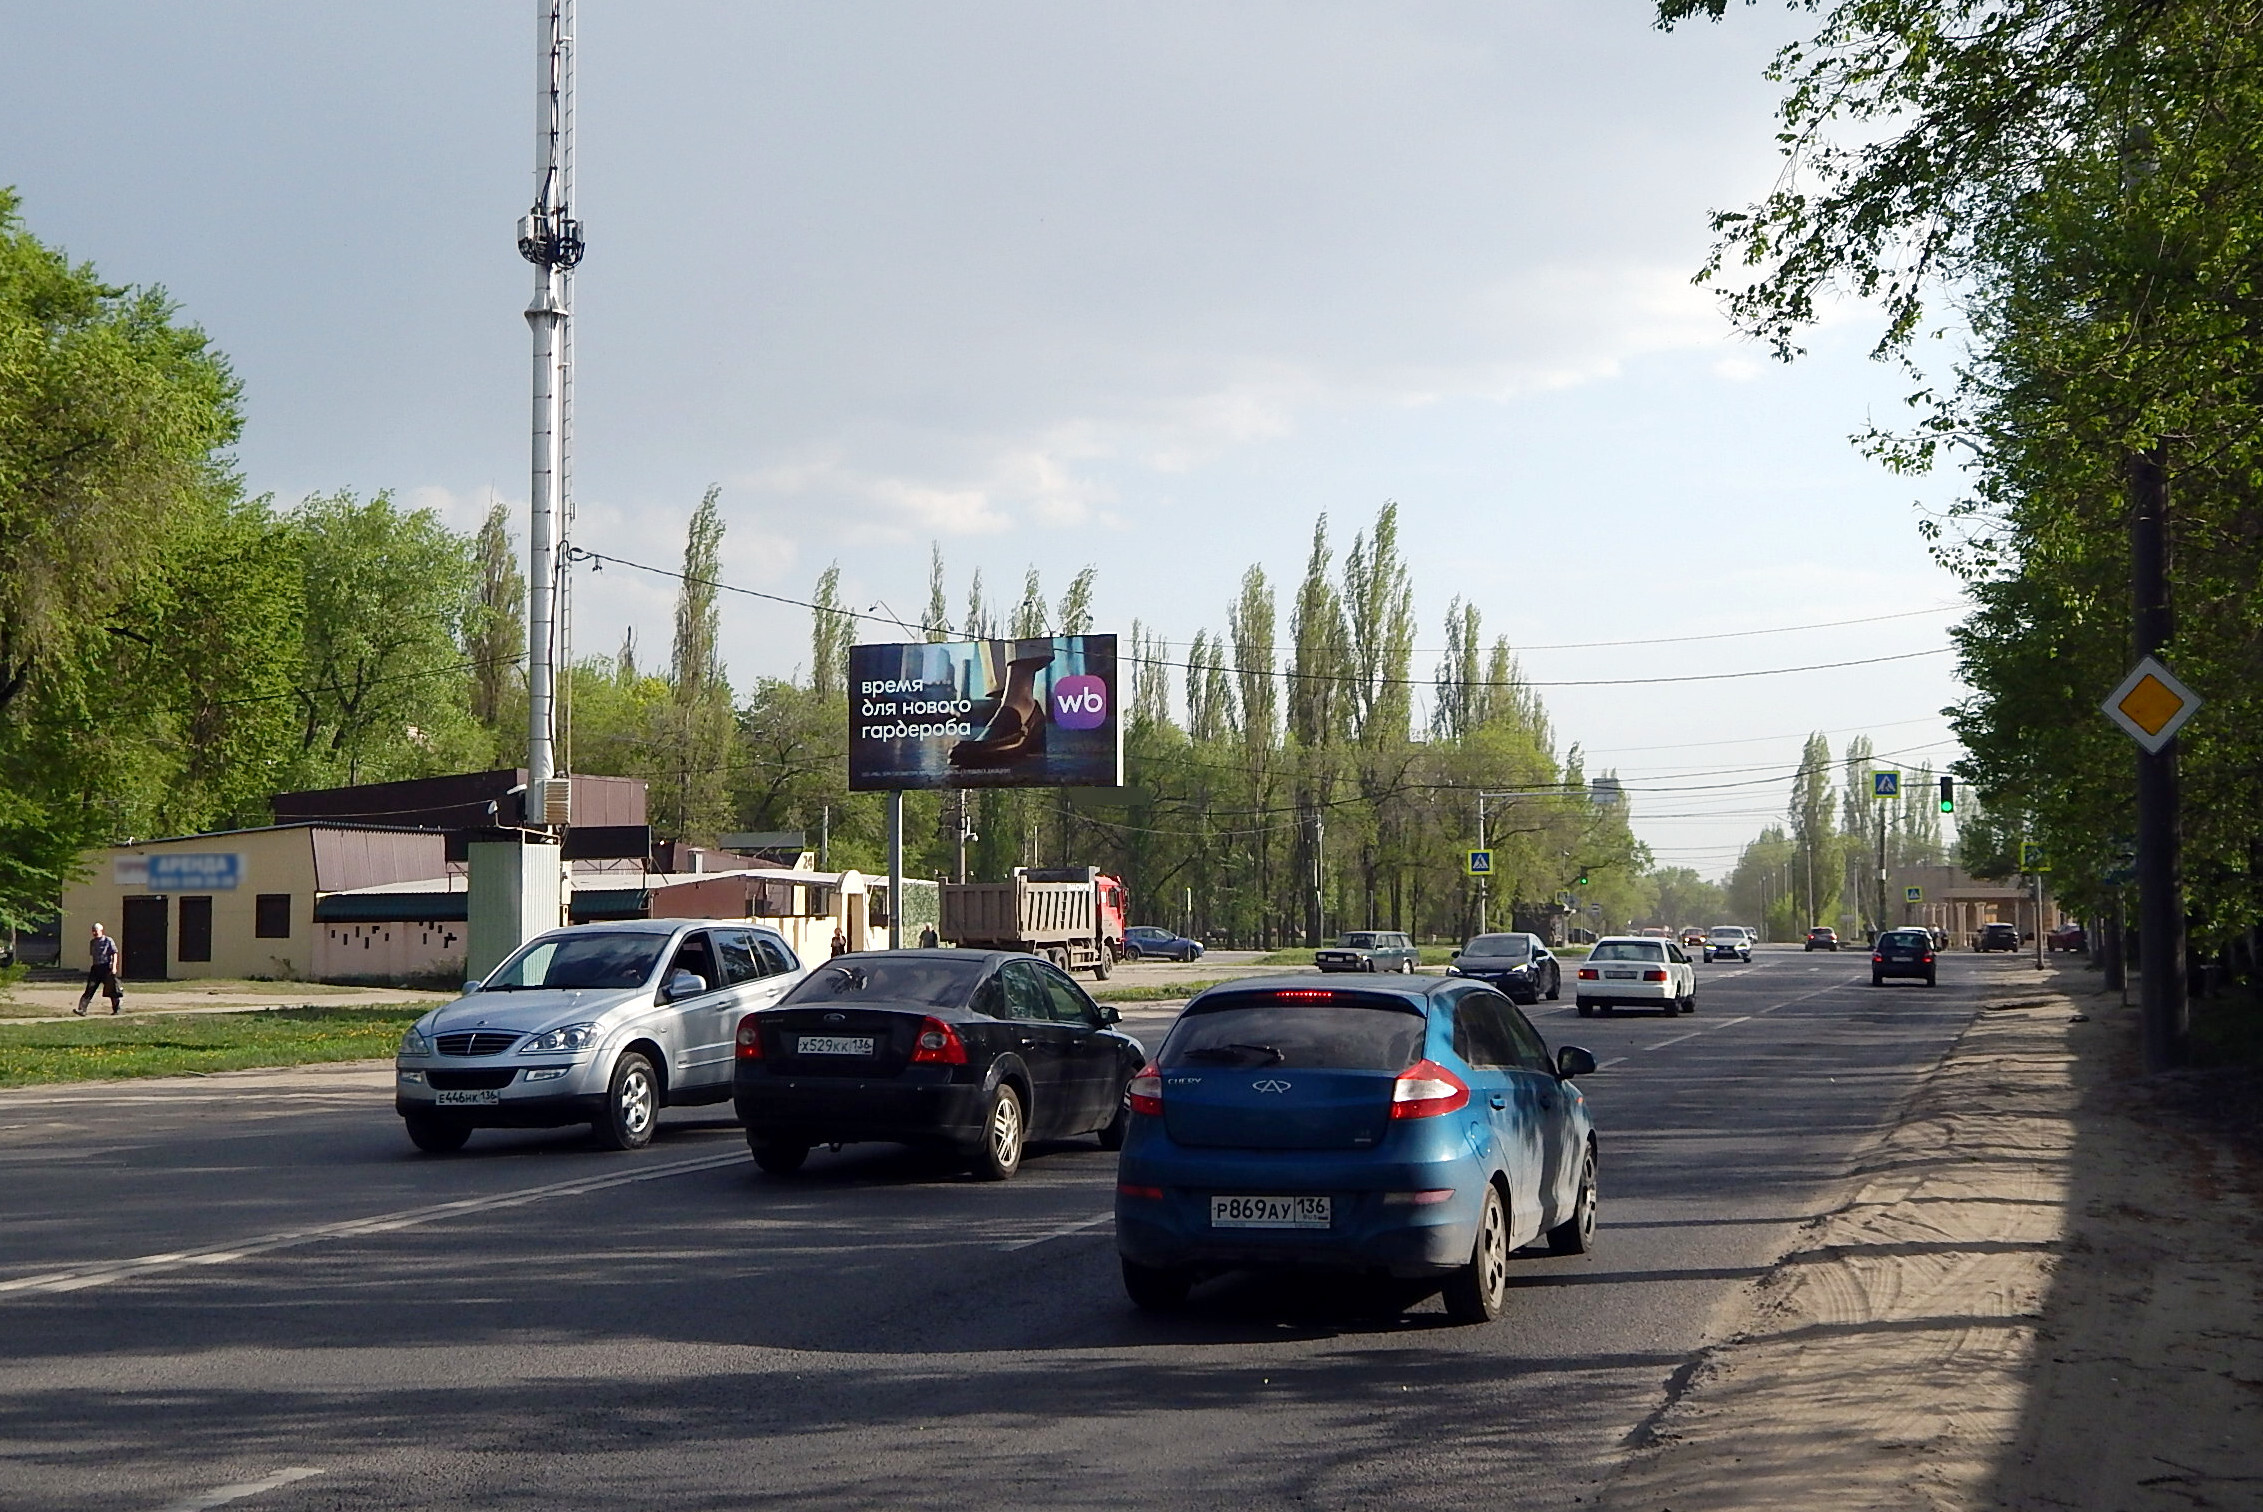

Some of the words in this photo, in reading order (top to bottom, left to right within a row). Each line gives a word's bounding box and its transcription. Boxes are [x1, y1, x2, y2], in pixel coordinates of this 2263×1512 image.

[862, 679, 923, 698] время
[861, 699, 897, 717] для
[902, 700, 972, 715] нового
[1057, 686, 1103, 714] wb
[862, 718, 971, 742] гардероба
[803, 855, 813, 869] 24
[1297, 1198, 1326, 1214] 136
